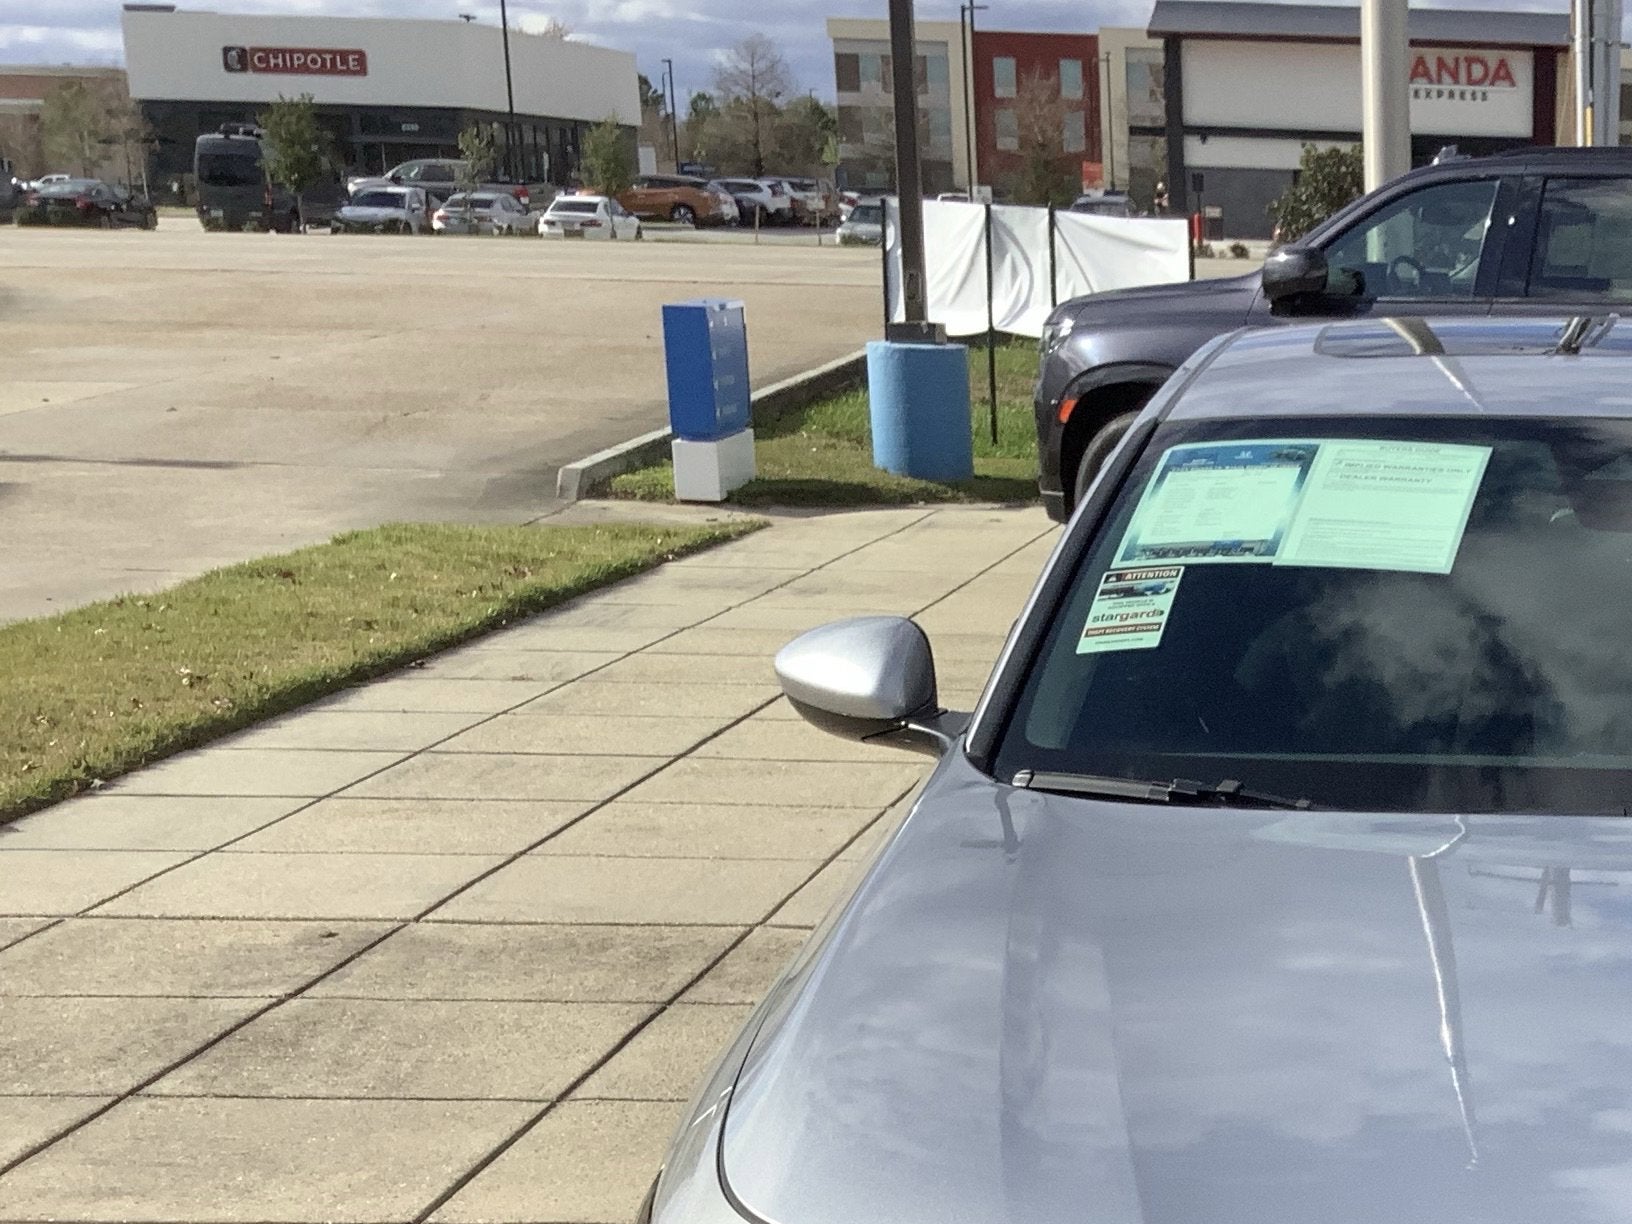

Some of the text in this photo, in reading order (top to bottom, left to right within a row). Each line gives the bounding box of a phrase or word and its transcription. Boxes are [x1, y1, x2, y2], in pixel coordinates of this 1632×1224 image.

[253, 52, 361, 71] CHIPOTLE
[1410, 56, 1516, 87] ANDA
[1413, 89, 1488, 102] EXPRESS
[1125, 570, 1177, 580] ATTENTION
